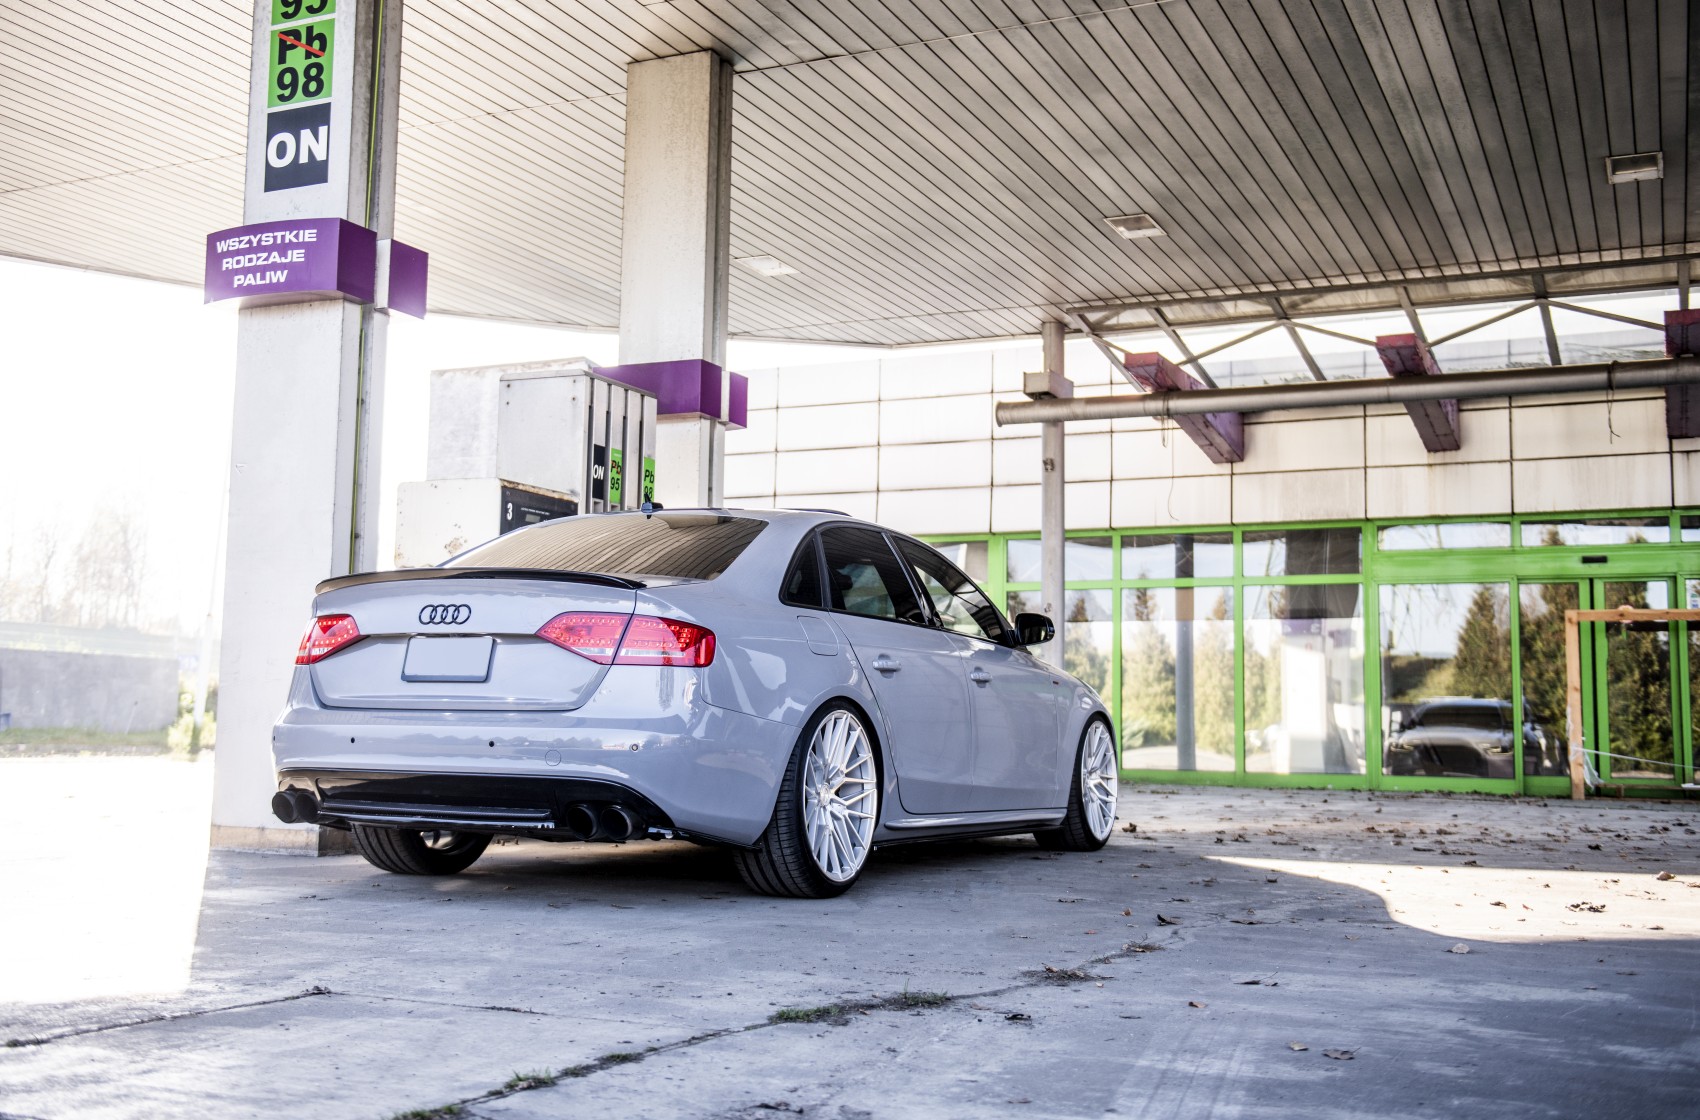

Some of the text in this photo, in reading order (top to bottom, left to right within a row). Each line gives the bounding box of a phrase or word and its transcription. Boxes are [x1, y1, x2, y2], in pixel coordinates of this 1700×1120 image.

[278, 25, 327, 65] Pb
[277, 62, 325, 103] 98
[267, 125, 329, 169] ON
[216, 229, 318, 253] WSZYSTKIE
[222, 249, 306, 271] RODZAJE
[233, 269, 289, 288] PALIW
[593, 464, 605, 480] ON
[610, 460, 622, 475] Pb
[644, 469, 655, 484] Pb
[610, 477, 620, 491] 95
[506, 502, 513, 520] 3
